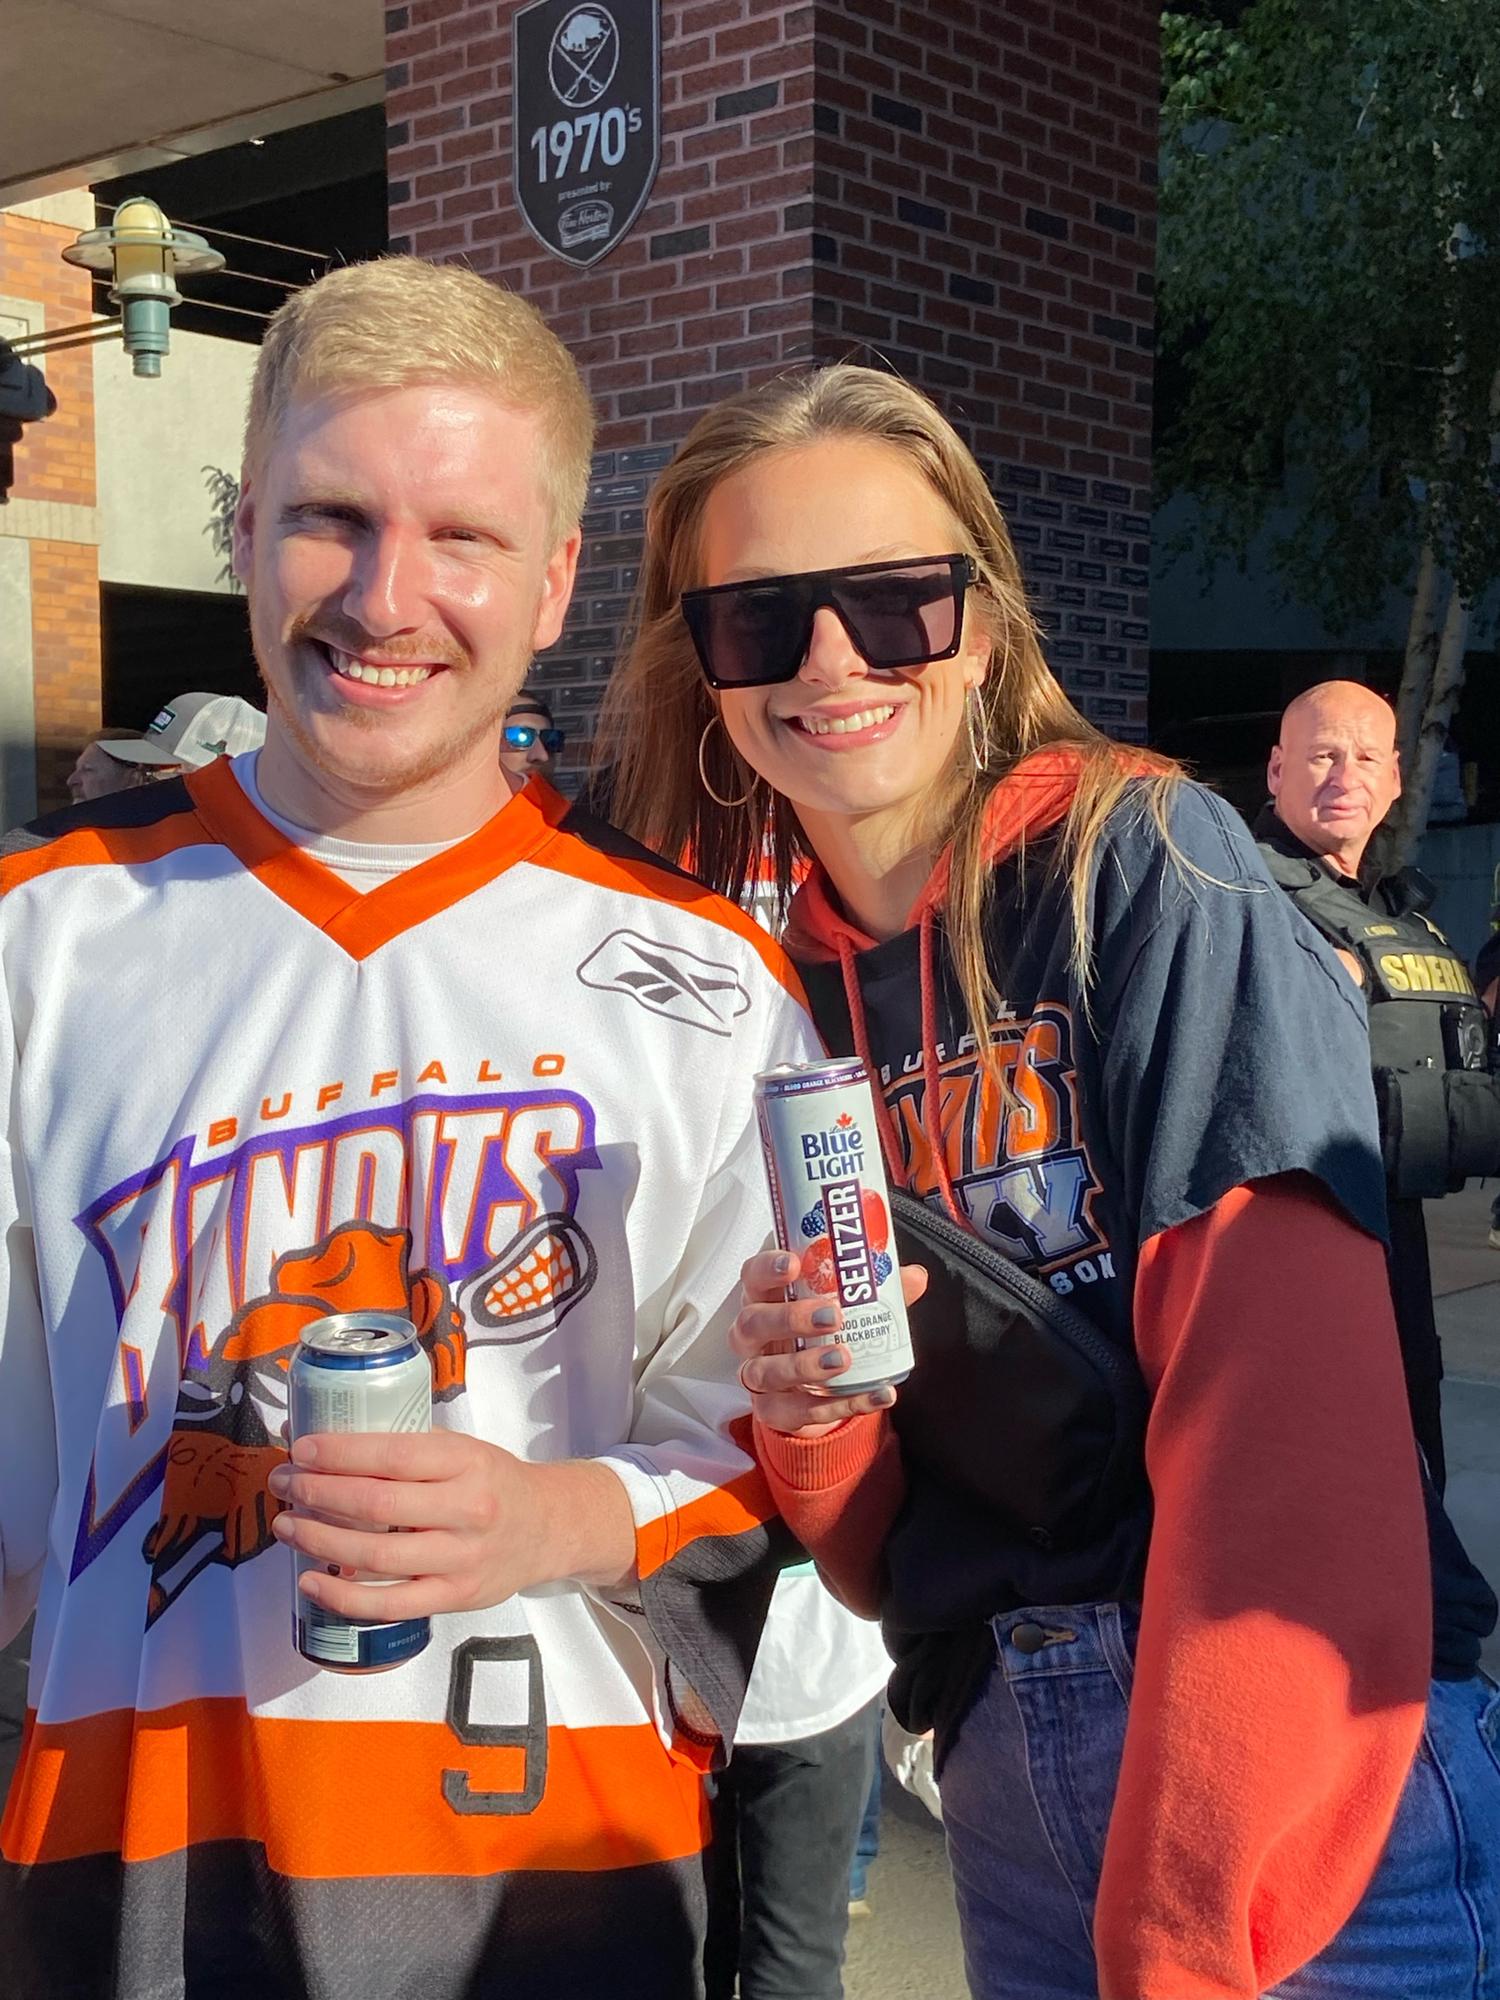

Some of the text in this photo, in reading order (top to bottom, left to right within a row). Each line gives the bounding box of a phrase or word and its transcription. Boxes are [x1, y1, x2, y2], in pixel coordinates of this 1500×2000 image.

[531, 103, 642, 183] 1970's
[558, 183, 599, 203] presented
[1380, 953, 1477, 997] SHERI
[207, 1054, 565, 1147] BUFFALO
[801, 1128, 863, 1160] Blue
[805, 1151, 865, 1181] LIGHT
[828, 1183, 872, 1303] SELTZER
[834, 1324, 890, 1345] BLACKBERRY
[840, 1310, 893, 1331] OOD ORANGE
[441, 1633, 549, 1816] 9
